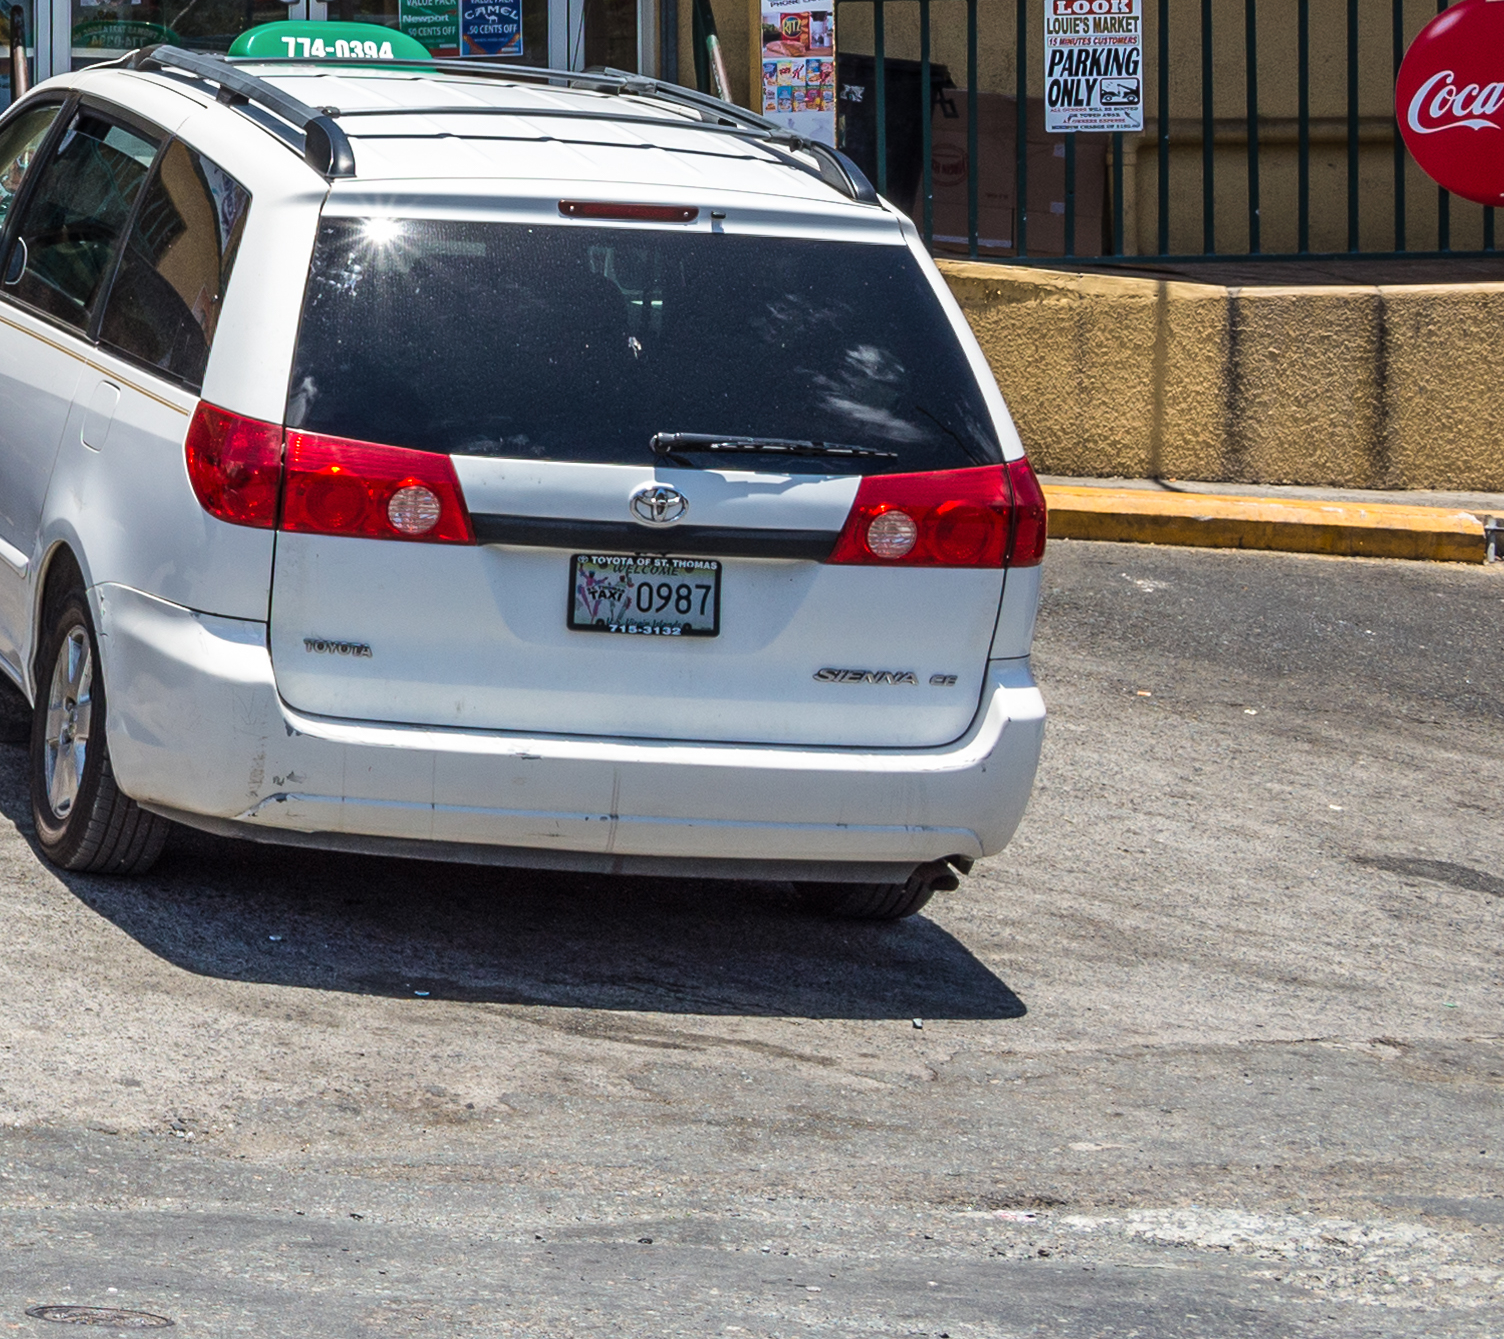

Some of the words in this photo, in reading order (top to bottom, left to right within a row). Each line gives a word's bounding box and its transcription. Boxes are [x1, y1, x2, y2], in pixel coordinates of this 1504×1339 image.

[464, 6, 518, 20] CAMEL
[1056, 0, 1129, 14] LOOK
[403, 14, 449, 23] Newport
[1047, 17, 1089, 34] LOUIE'S
[1093, 16, 1139, 33] MARKET
[479, 25, 502, 34] CENTS
[281, 37, 394, 60] 774-0394
[1048, 47, 1140, 77] PARKING
[1048, 78, 1099, 107] ONLY
[591, 556, 634, 566] TOYOTA
[638, 558, 651, 567] OF
[654, 558, 669, 567] ST.
[672, 559, 718, 570] THOMAS
[612, 564, 681, 576] WELCOME
[589, 590, 624, 602] TAXI
[636, 582, 712, 616] 0987
[609, 624, 682, 636] 715-3132
[303, 637, 373, 658] TOYOTA
[812, 667, 919, 686] SIENNA
[928, 673, 958, 687] CE
